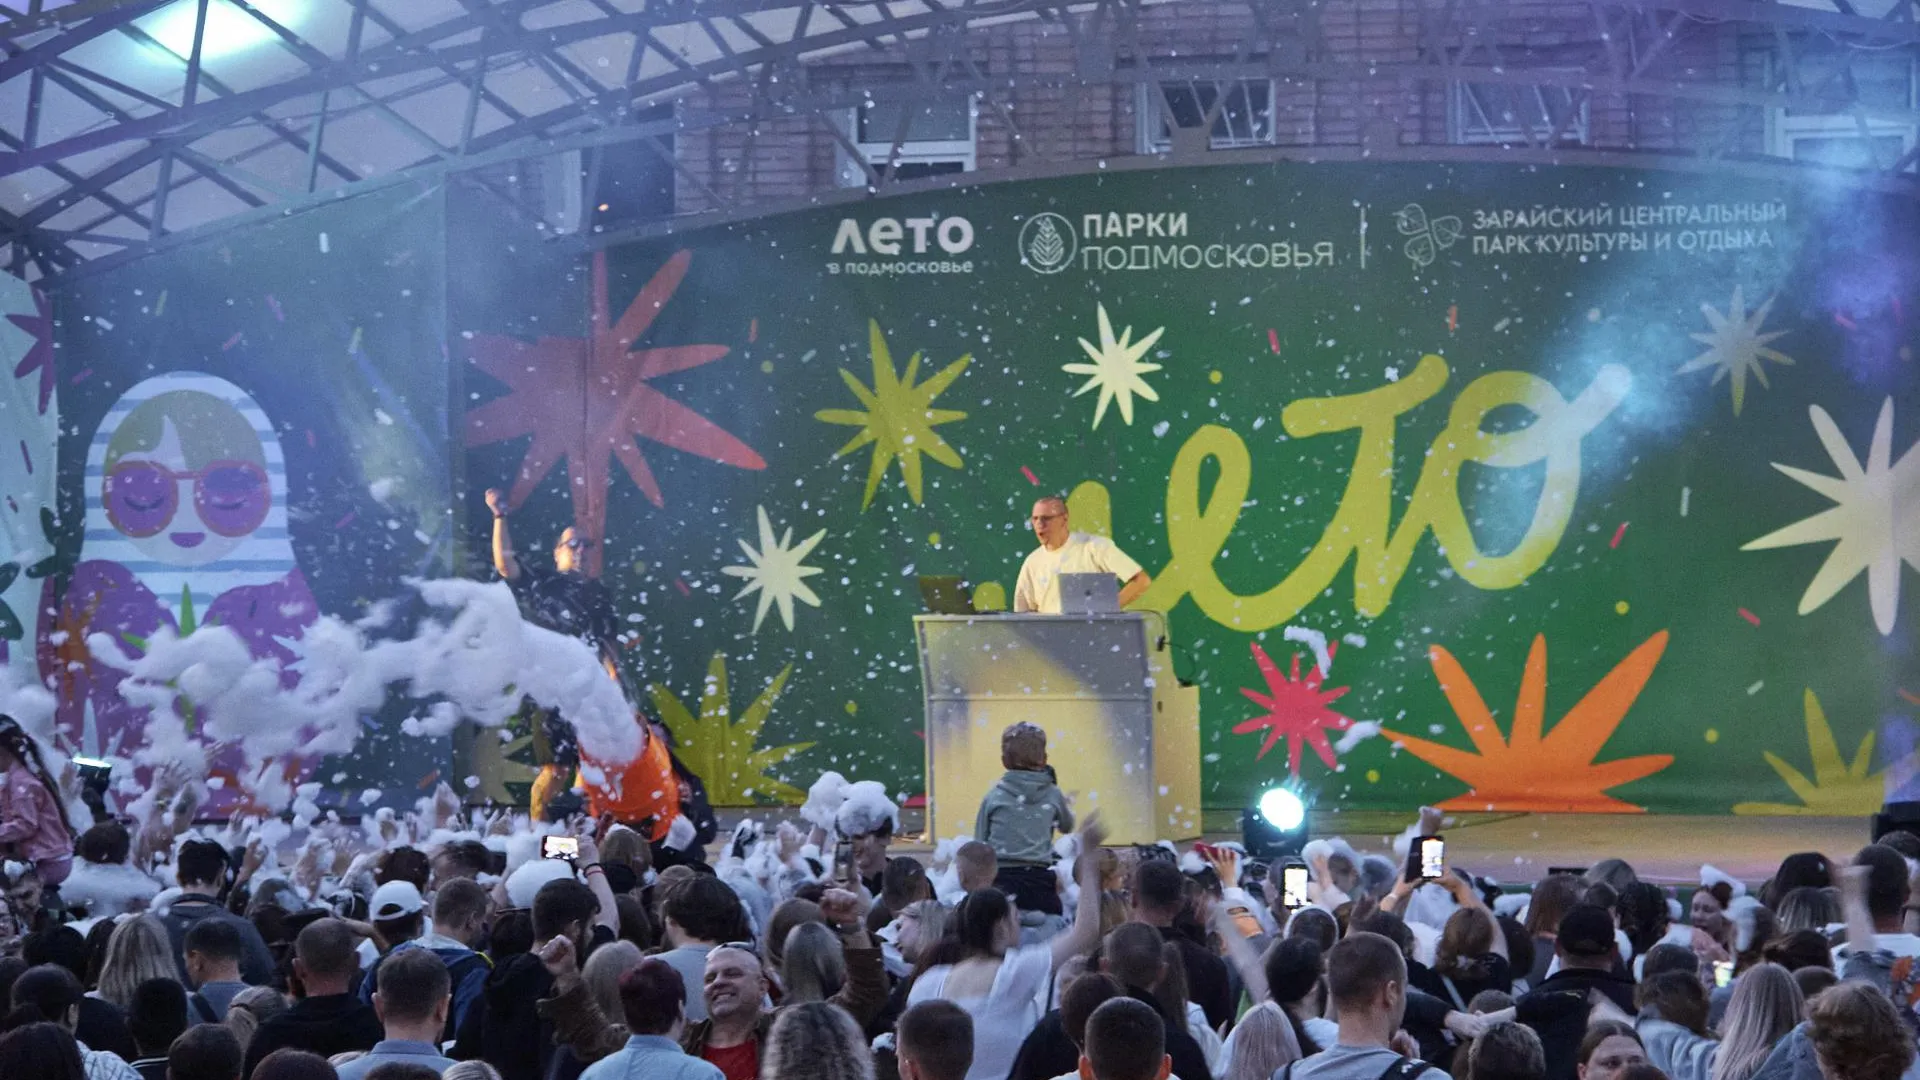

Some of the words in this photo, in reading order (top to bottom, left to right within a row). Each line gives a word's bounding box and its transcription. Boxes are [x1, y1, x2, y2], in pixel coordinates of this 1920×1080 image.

[1083, 212, 1189, 238] ПАРКИ
[1473, 204, 1613, 230] ЗАРАЙСКИЙ
[1619, 200, 1788, 228] ЦЕНТРАЛЬНЫЙ
[1473, 235, 1532, 255] ПАРК
[1536, 232, 1648, 253] КУЛЬТУРЫ
[1654, 231, 1671, 251] И
[1677, 228, 1775, 251] ОТДЫХА
[1081, 242, 1335, 271] ПОДМОСКОВЬЯ
